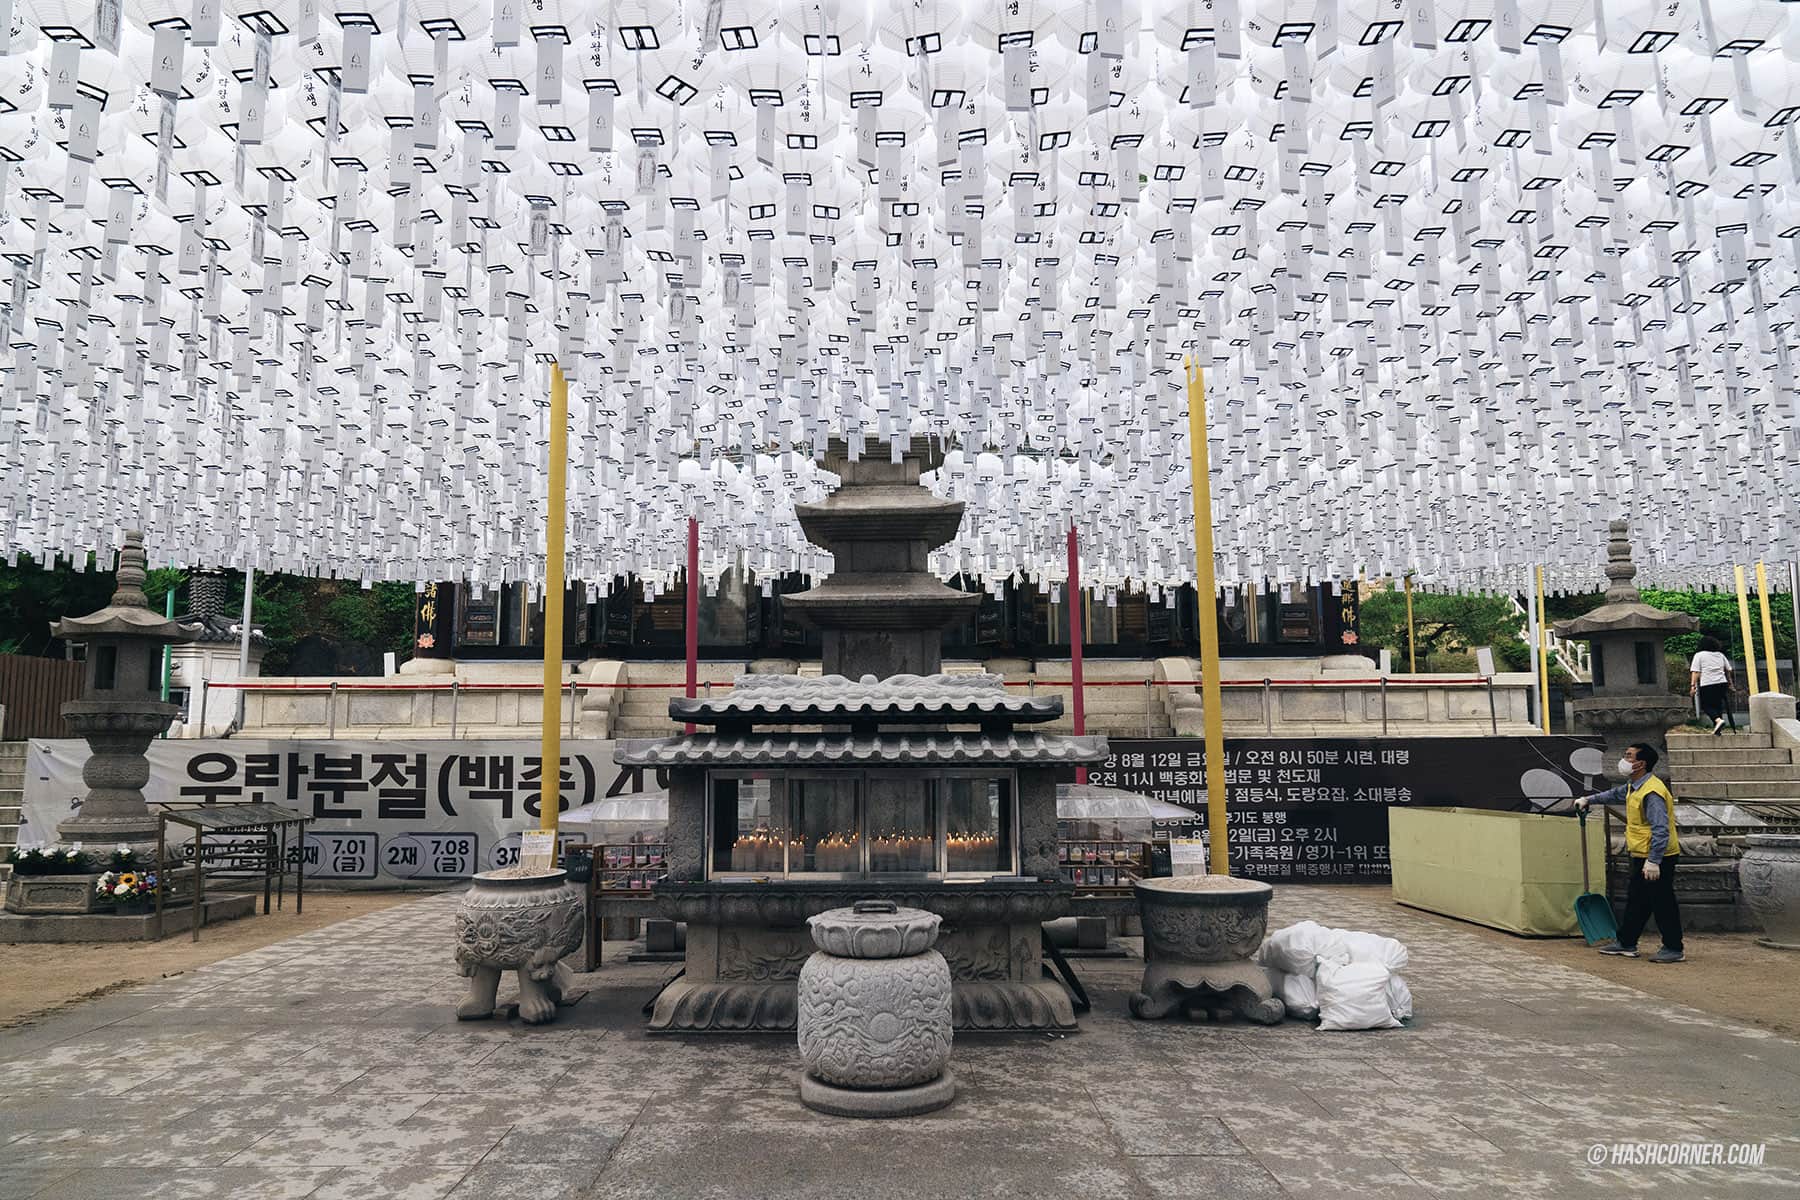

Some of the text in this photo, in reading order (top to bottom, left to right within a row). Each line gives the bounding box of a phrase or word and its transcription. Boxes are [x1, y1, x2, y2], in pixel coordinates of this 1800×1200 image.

[1121, 753, 1145, 767] 8월
[1151, 753, 1181, 767] 12일
[1246, 751, 1274, 766] 오전
[1279, 751, 1302, 765] 8시
[1307, 751, 1339, 765] 50분
[1381, 750, 1409, 765] 대령
[1088, 772, 1117, 786] 오전
[1123, 771, 1153, 786] 11시
[1159, 771, 1208, 785] 백중회
[1258, 769, 1272, 784] 및
[1277, 769, 1320, 783] 천도재
[1354, 787, 1412, 802] 소대봉송
[1262, 811, 1287, 825] 봉행
[1280, 828, 1310, 842] 오후
[1314, 828, 1337, 842] 2시
[332, 840, 366, 855] 7.01
[432, 840, 469, 855] 7.08
[333, 856, 365, 872] (금)
[388, 847, 417, 866] 2재
[434, 856, 465, 873] (금)
[1245, 863, 1291, 876] 우란분절
